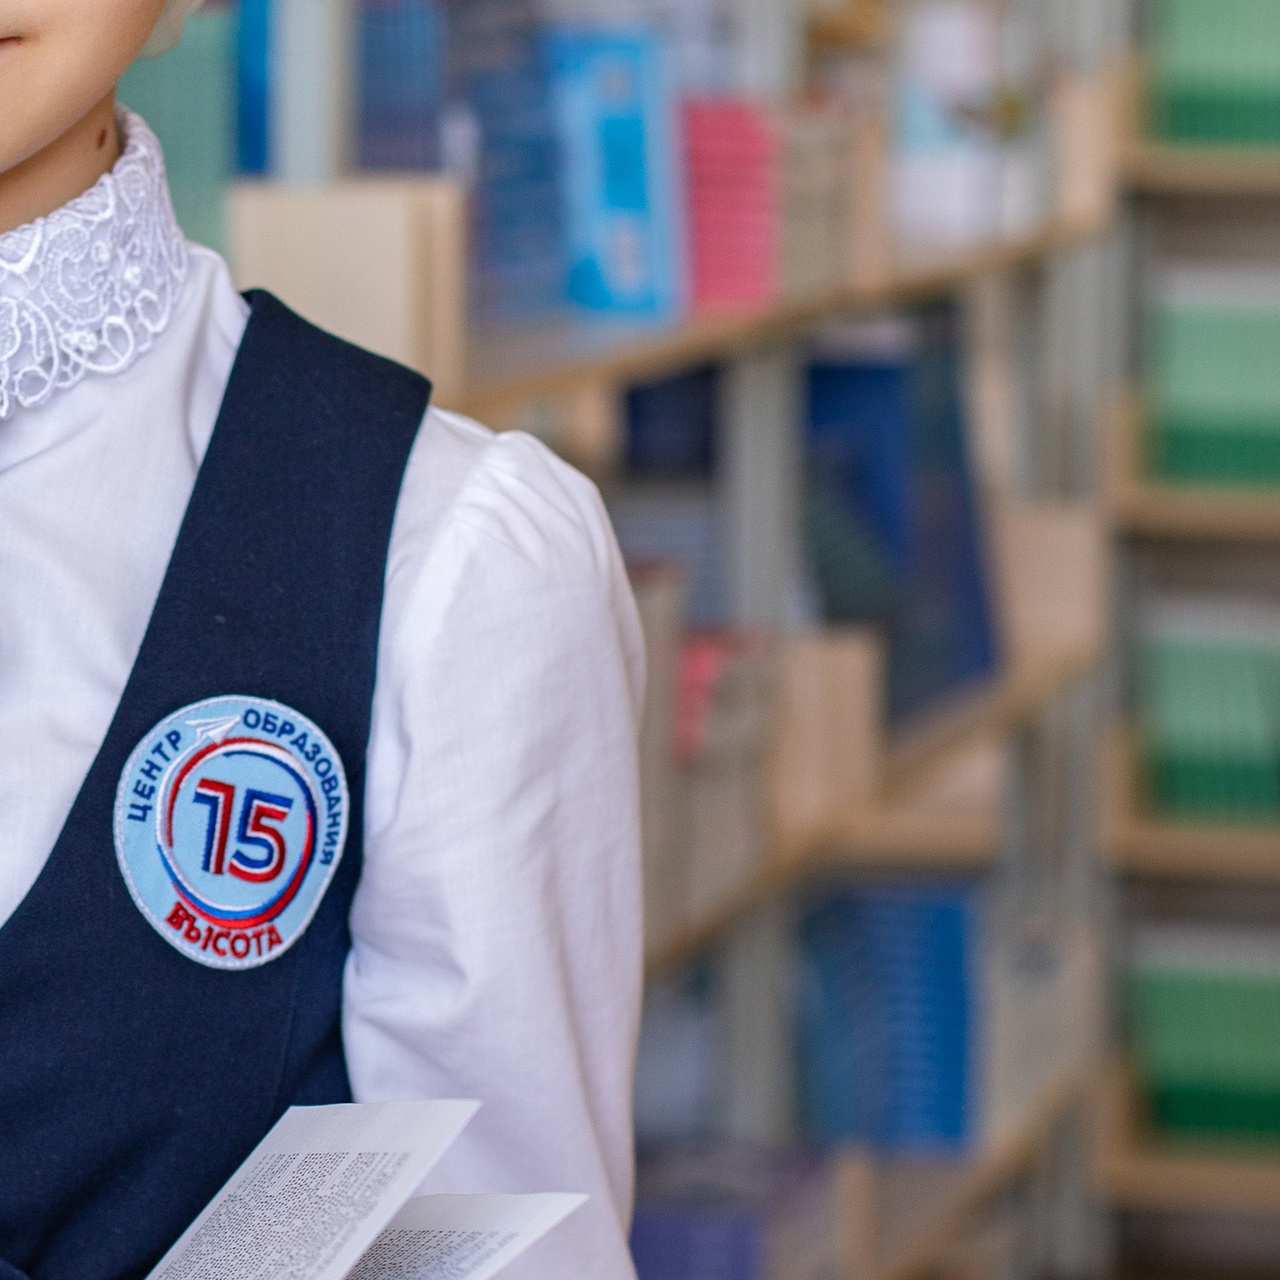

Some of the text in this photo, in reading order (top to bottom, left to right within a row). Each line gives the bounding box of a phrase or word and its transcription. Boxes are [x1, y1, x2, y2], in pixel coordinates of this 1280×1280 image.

[127, 708, 341, 866] ЦЕНТР ОБРАЗОВАНИЯ
[166, 901, 283, 959] ВЫСОТА
